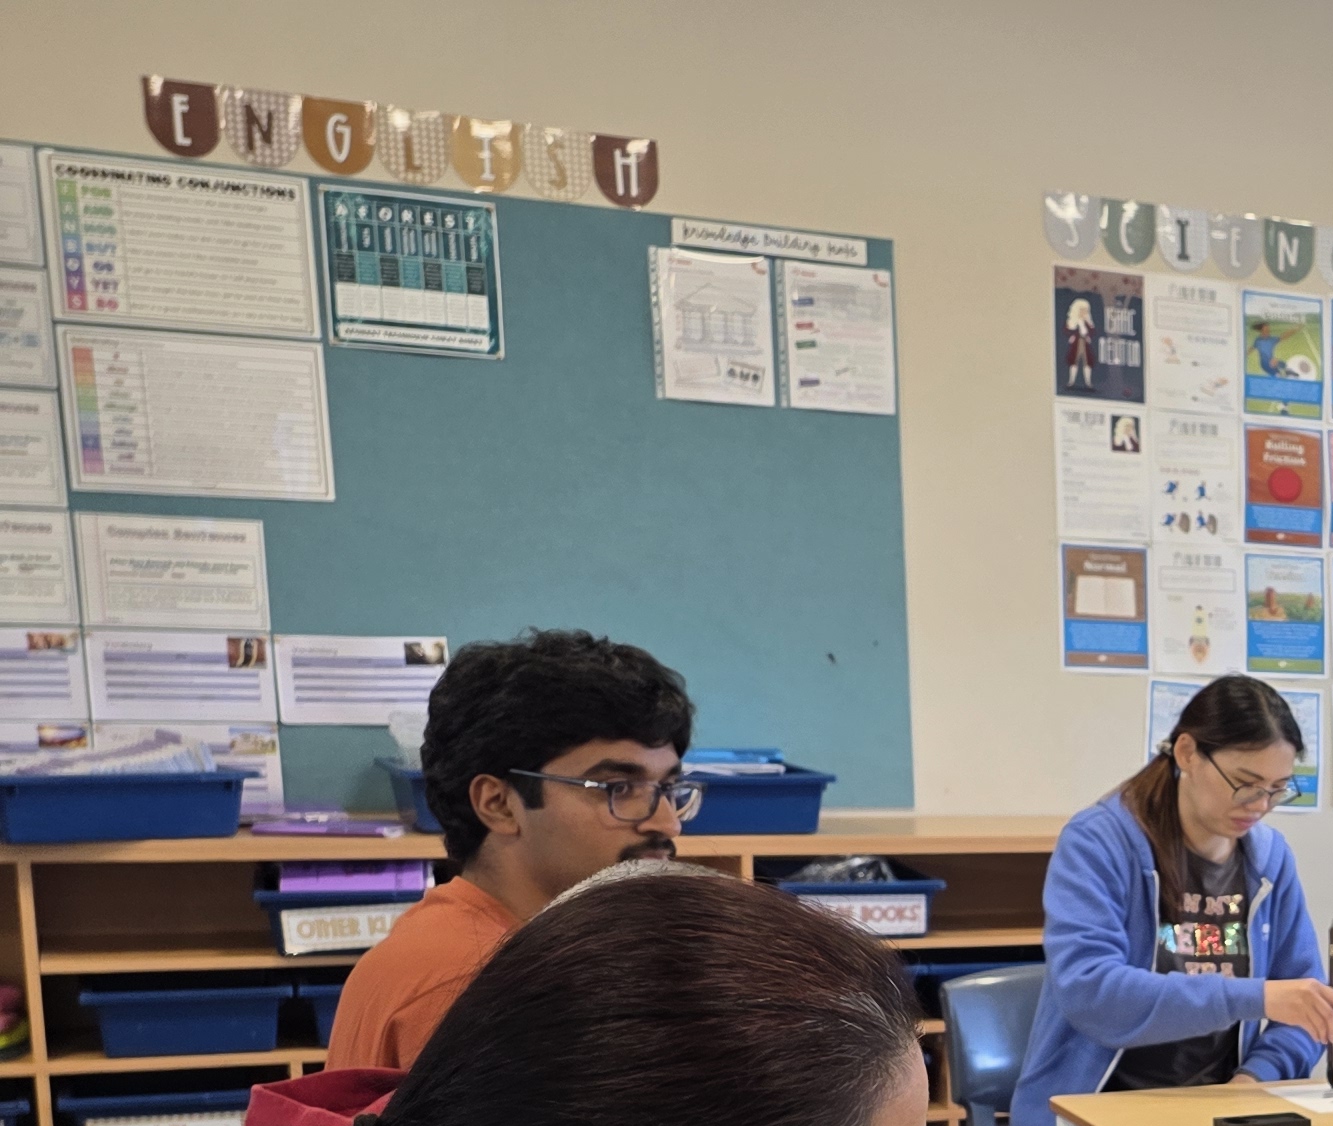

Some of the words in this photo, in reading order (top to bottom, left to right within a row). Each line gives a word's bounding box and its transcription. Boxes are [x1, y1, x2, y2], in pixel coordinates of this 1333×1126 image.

[172, 94, 638, 196] ENGLISH
[55, 163, 171, 187] COORDINATING
[176, 175, 296, 200] CONJUNCTIONS
[86, 242, 117, 255] BUT
[861, 904, 921, 922] BOOKS
[297, 917, 360, 939] OTHER
